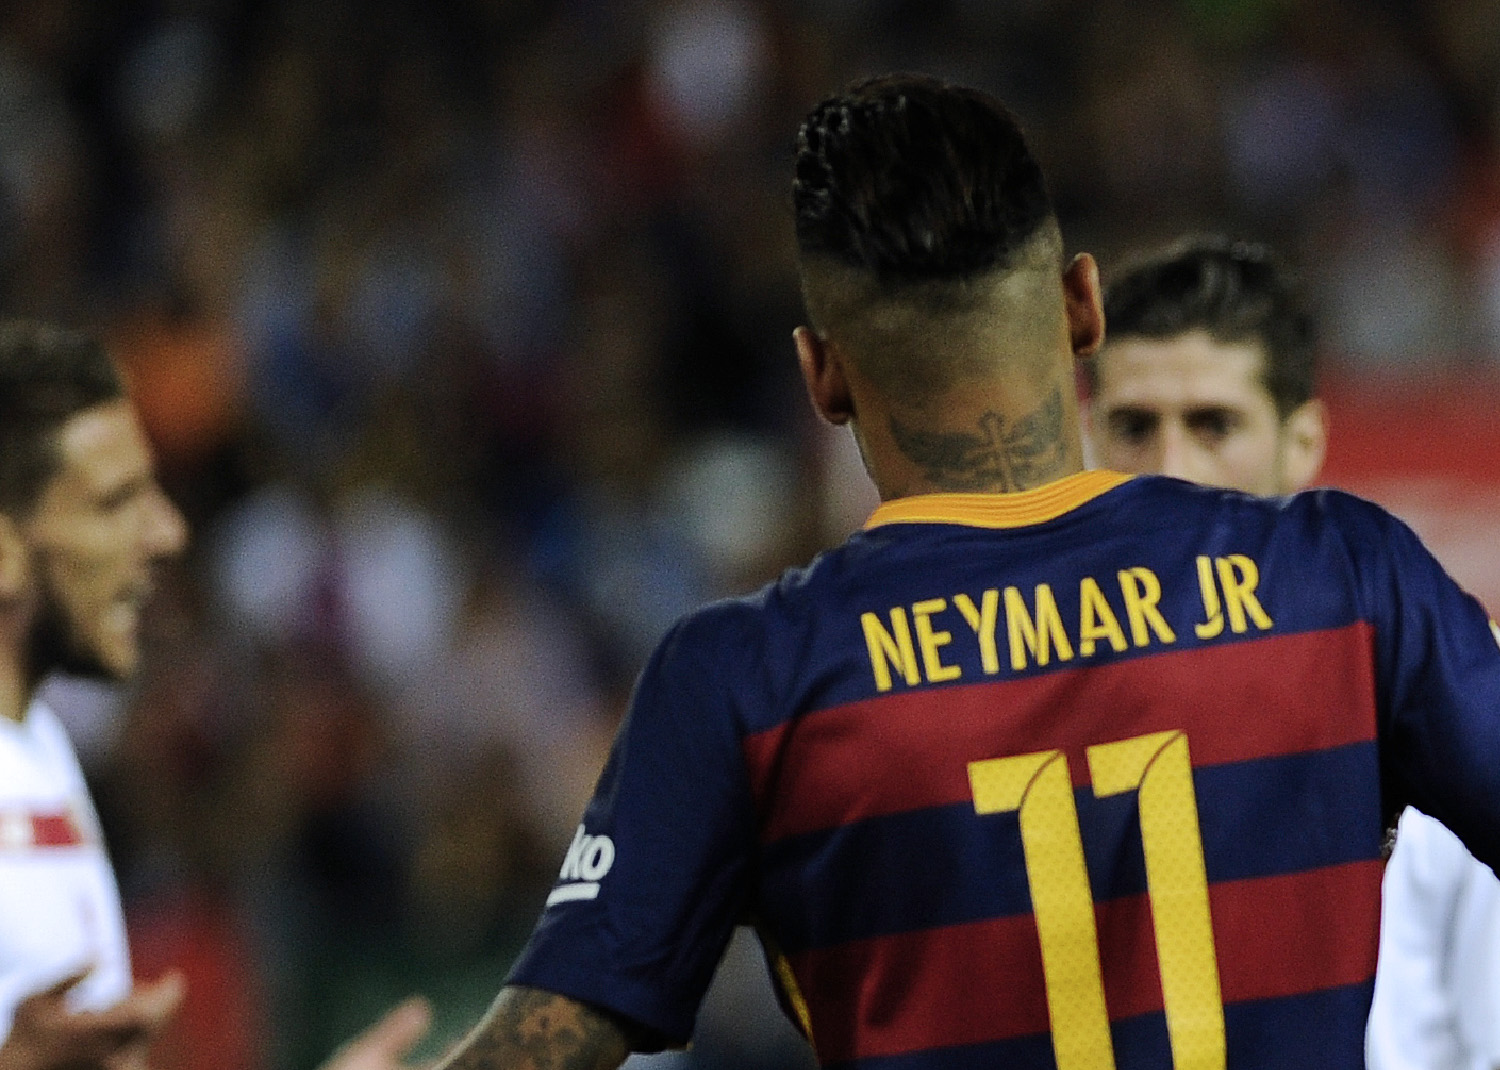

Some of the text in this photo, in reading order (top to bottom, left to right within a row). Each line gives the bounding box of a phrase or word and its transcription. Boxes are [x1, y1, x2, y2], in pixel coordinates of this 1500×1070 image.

[860, 566, 1177, 693] NEYMAR
[1194, 553, 1274, 639] JR
[559, 823, 616, 881] ko
